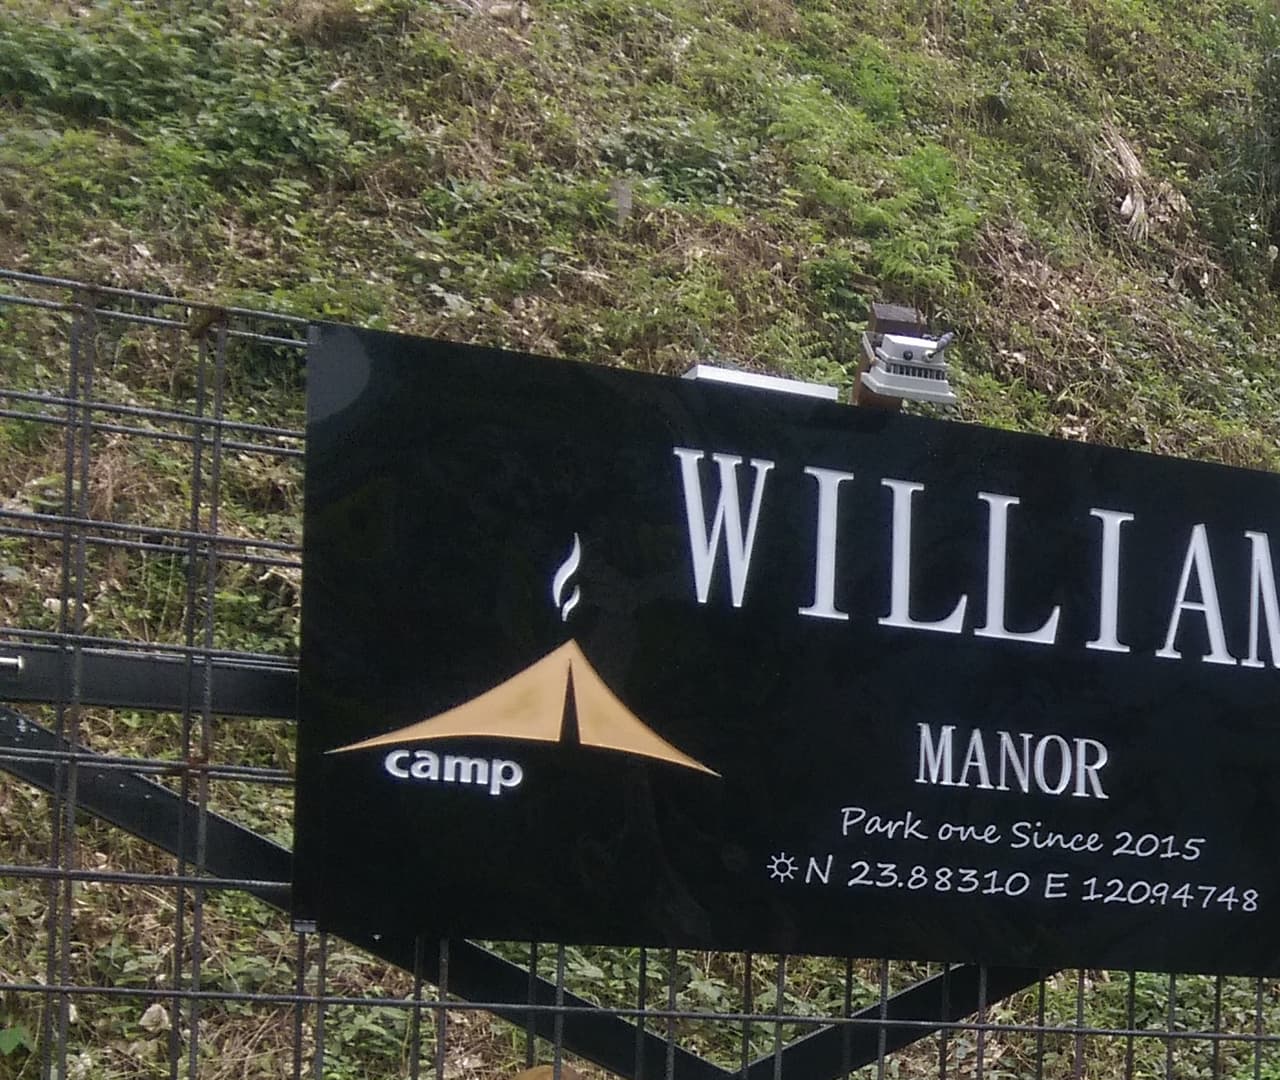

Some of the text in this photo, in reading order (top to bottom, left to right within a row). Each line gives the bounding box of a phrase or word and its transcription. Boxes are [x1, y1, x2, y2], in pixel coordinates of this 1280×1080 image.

[384, 749, 524, 796] camp
[914, 722, 1109, 800] MANOR
[840, 807, 1206, 861] Park one Since 2015
[804, 854, 1260, 913] N 23.88310 E 120.94748
